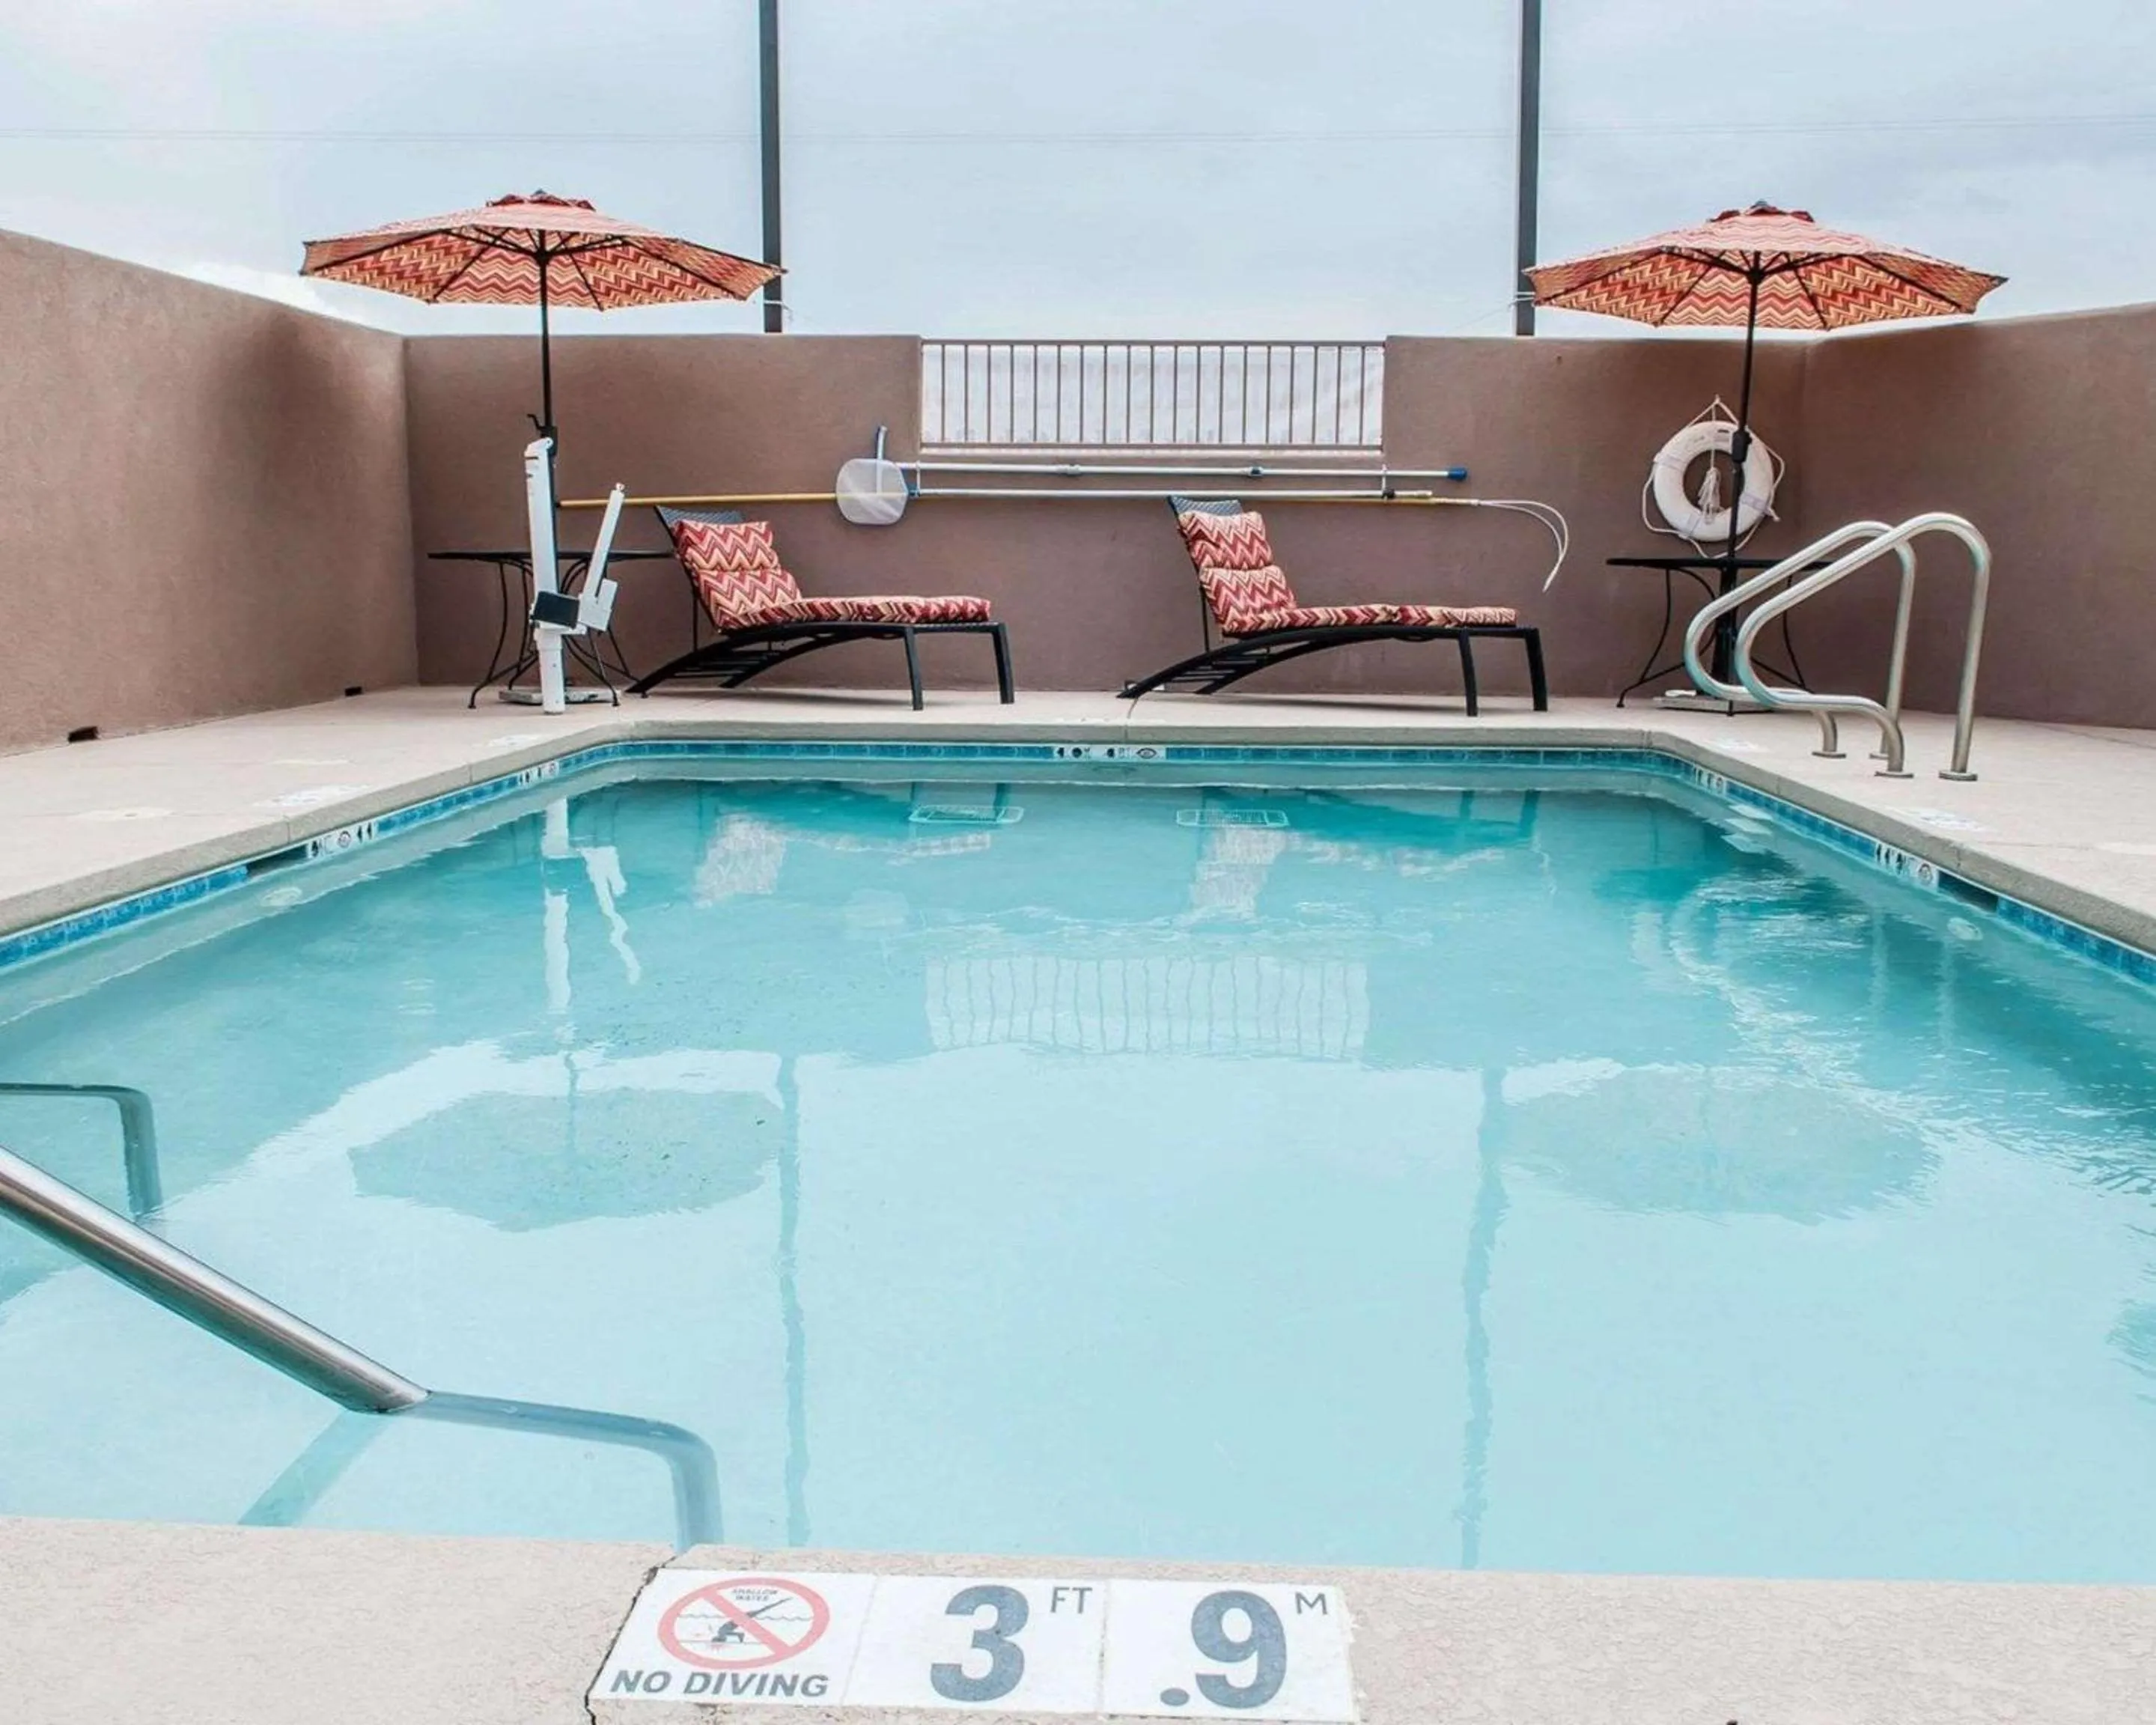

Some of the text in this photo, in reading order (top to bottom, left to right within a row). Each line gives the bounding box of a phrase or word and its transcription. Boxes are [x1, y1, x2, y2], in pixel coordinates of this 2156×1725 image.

[610, 1670, 830, 1697] NO DIVING
[931, 1584, 1093, 1702] 3 FT
[1160, 1589, 1328, 1709] .9 M
